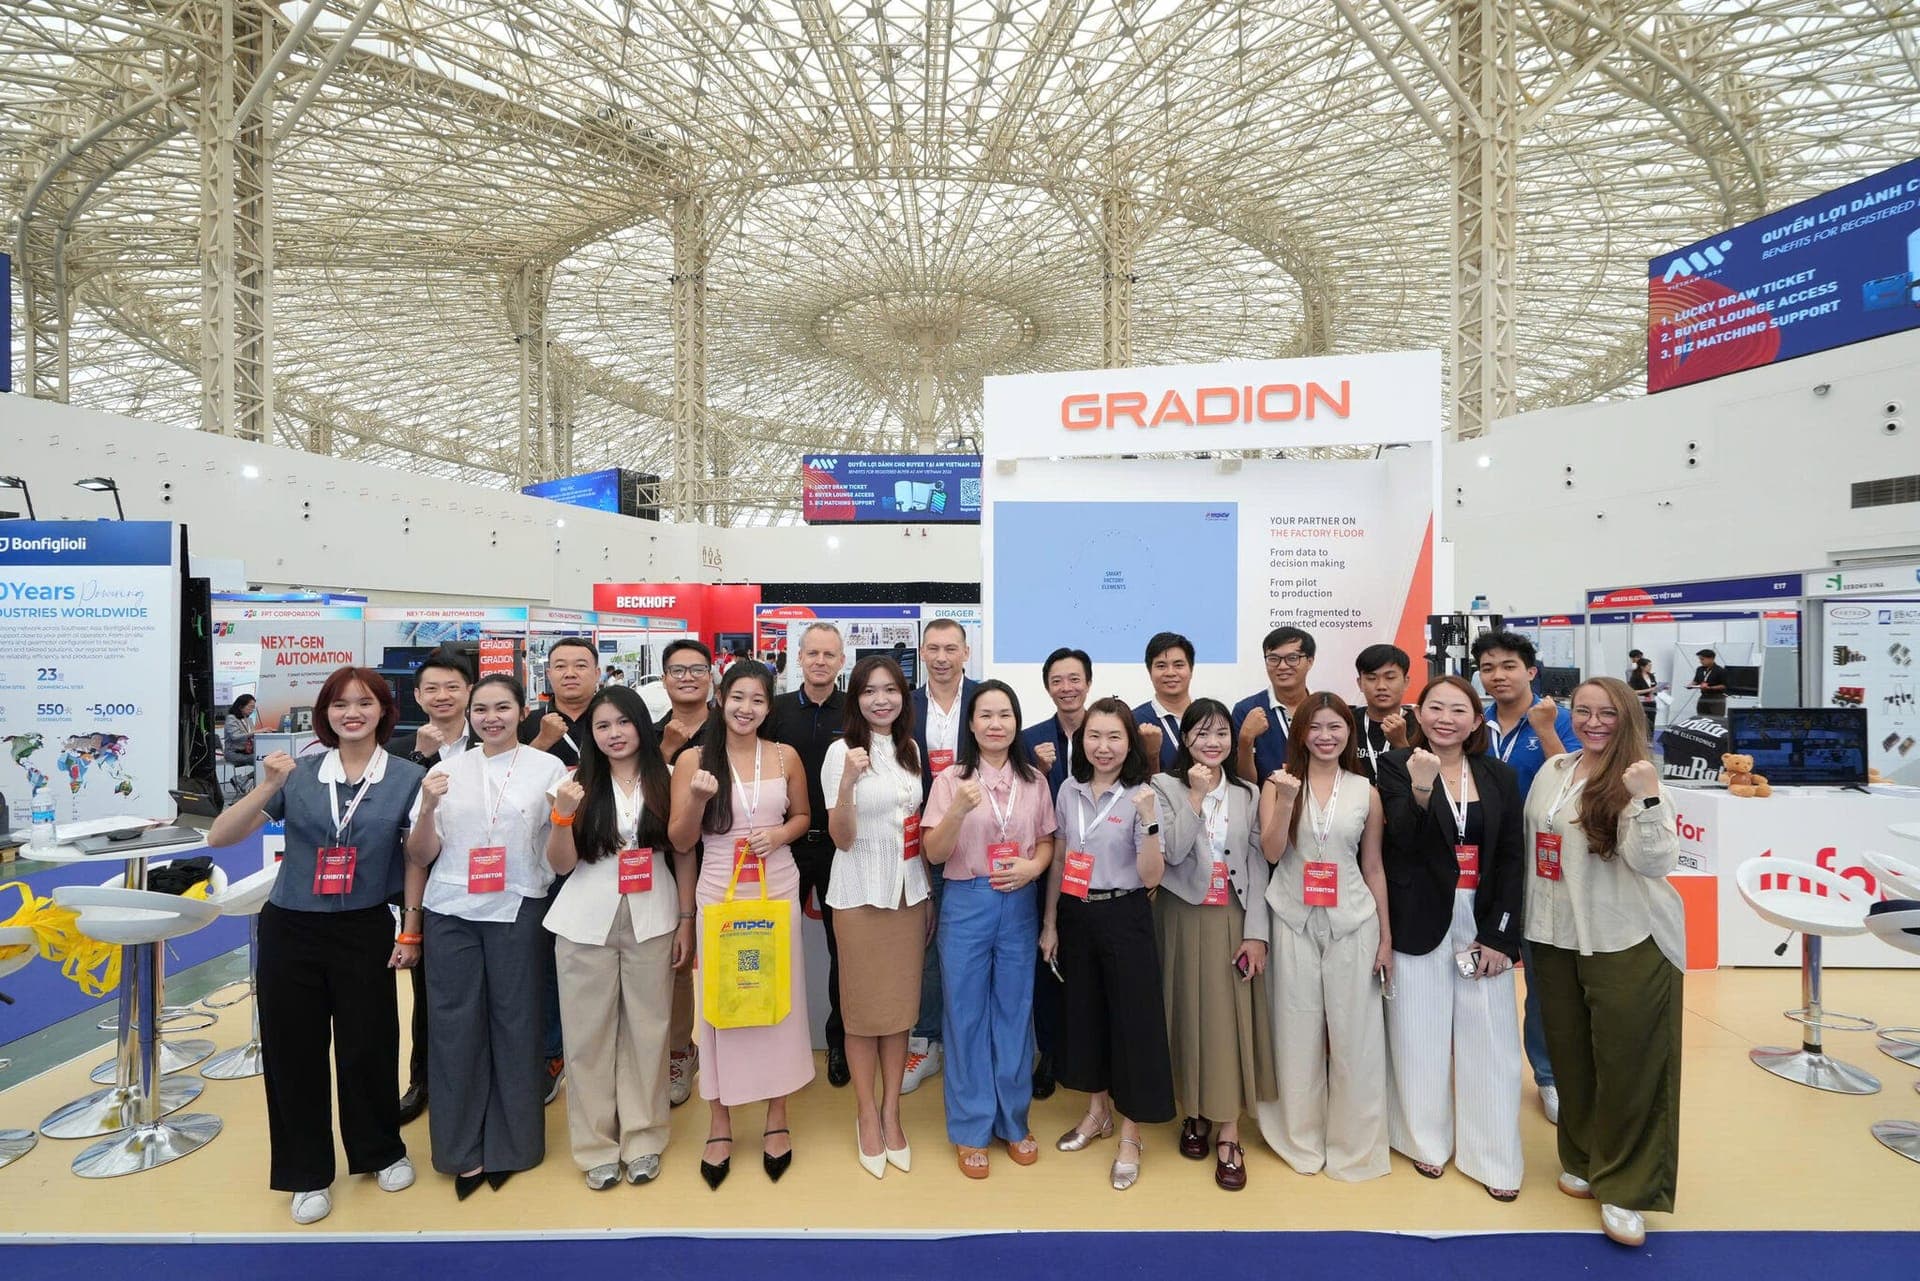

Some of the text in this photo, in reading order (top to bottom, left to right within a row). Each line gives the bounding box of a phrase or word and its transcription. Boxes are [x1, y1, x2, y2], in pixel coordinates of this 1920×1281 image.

[1818, 204, 1847, 222] LỢI
[1850, 184, 1902, 212] DÀNH
[1762, 200, 1916, 260] BENEFITS FOR REGISTERED
[1661, 268, 1817, 326] 1. LUCKY DRAW TICKET
[1660, 281, 1838, 343] 2. BUYER LOUNGE ACCESS
[1660, 299, 1842, 360] 3. BIZ MATCHING SUPPORT
[1061, 380, 1351, 431] GRADION
[1270, 516, 1356, 525] YOUR PARTNER ON
[1270, 529, 1364, 537] THE FACTORY FLOOR
[12, 537, 87, 553] Bonfiglioli
[1270, 548, 1294, 556] From
[1296, 548, 1316, 556] data
[1270, 559, 1345, 569] decision making
[1270, 578, 1317, 588] From pilot
[10, 582, 75, 600] Years
[1282, 589, 1332, 599] production
[616, 596, 676, 608] BECKHOFF
[0, 607, 148, 618] USTRIES WORLDWIDE
[1270, 608, 1294, 616] From
[1296, 608, 1350, 618] fragmented
[1320, 620, 1373, 629] ecosystems
[261, 636, 324, 649] NEXT-GEN
[480, 641, 514, 650] GRADION
[276, 652, 353, 666] AUTOMATION
[480, 656, 514, 664] GRADION
[37, 668, 57, 680] 23
[37, 704, 64, 715] 550
[86, 704, 135, 717] ~5,000
[1680, 732, 1716, 748] ELECTRONICS
[734, 920, 774, 930] mpdv
